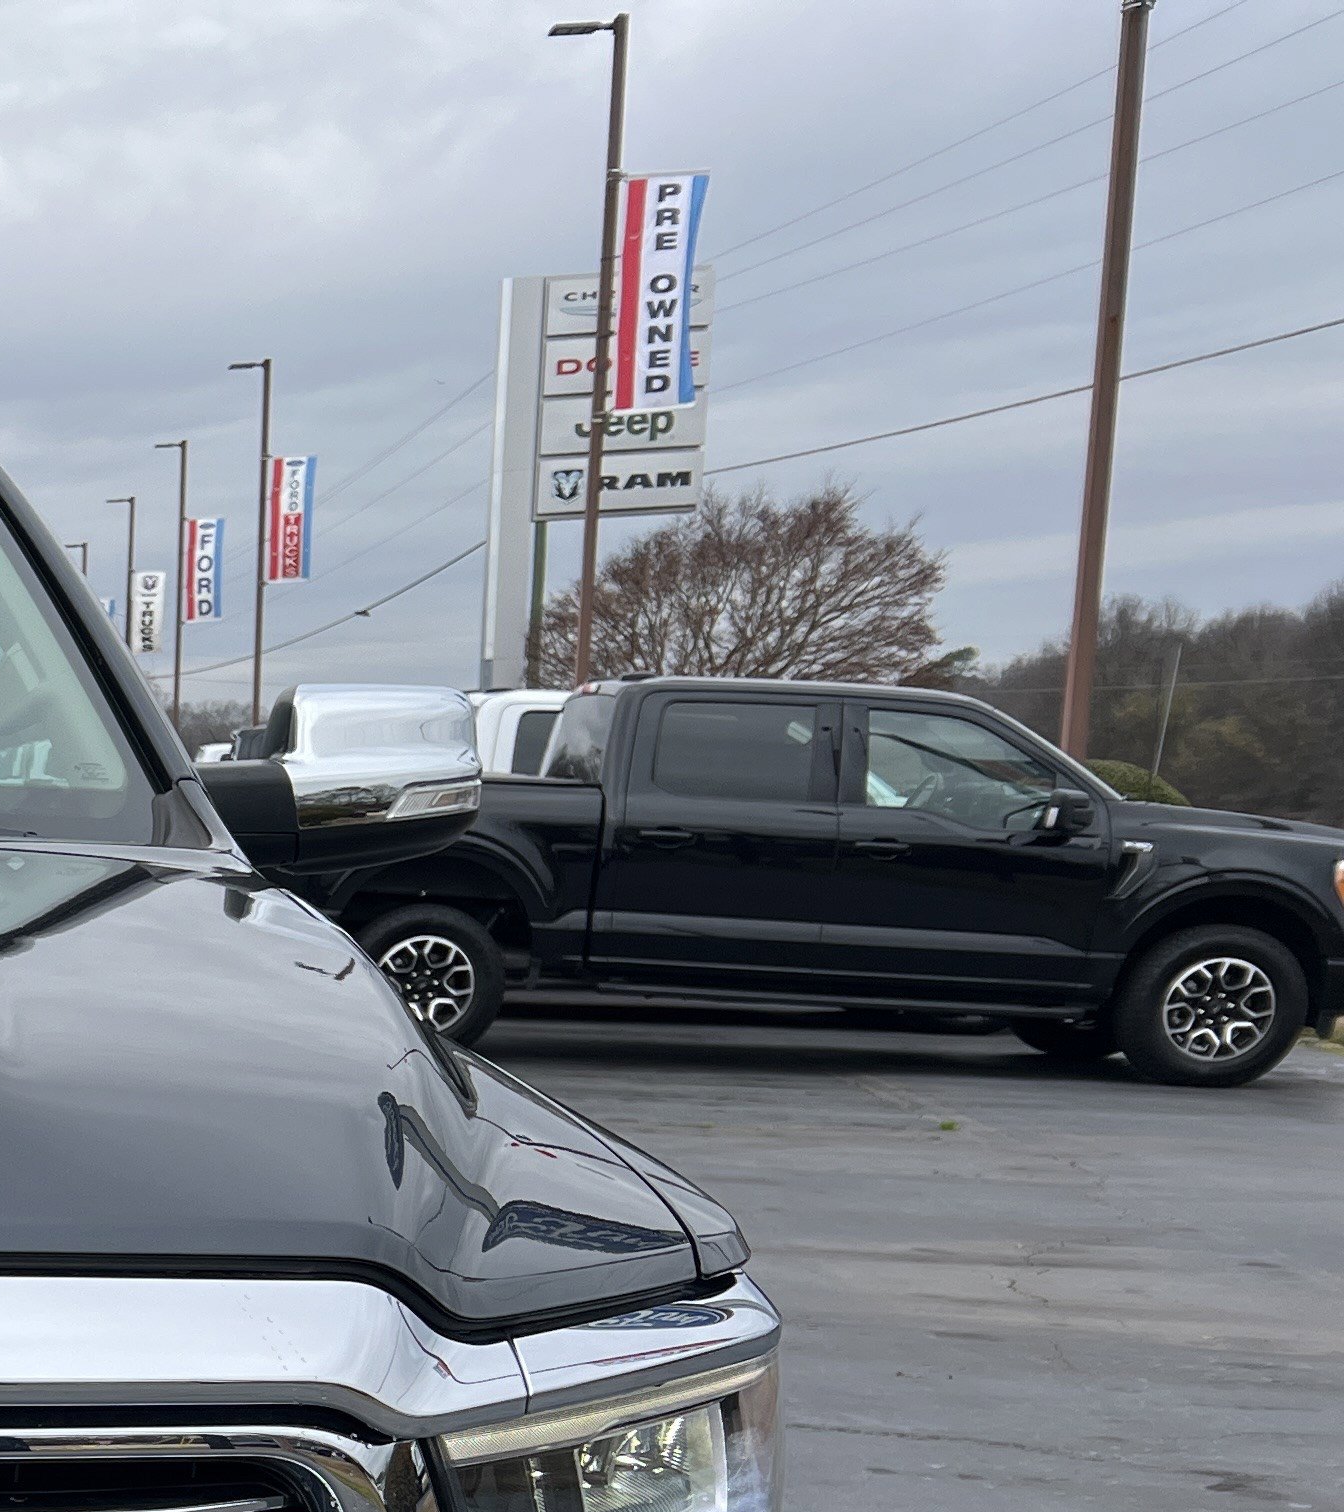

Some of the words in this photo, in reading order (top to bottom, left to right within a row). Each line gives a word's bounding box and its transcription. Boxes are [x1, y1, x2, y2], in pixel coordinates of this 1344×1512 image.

[655, 183, 682, 252] PRE
[645, 273, 678, 394] OWNED
[598, 470, 692, 491] RAM
[197, 533, 214, 617] FORD
[284, 514, 299, 577] TRUCKS
[140, 601, 154, 652] TRUCKS
